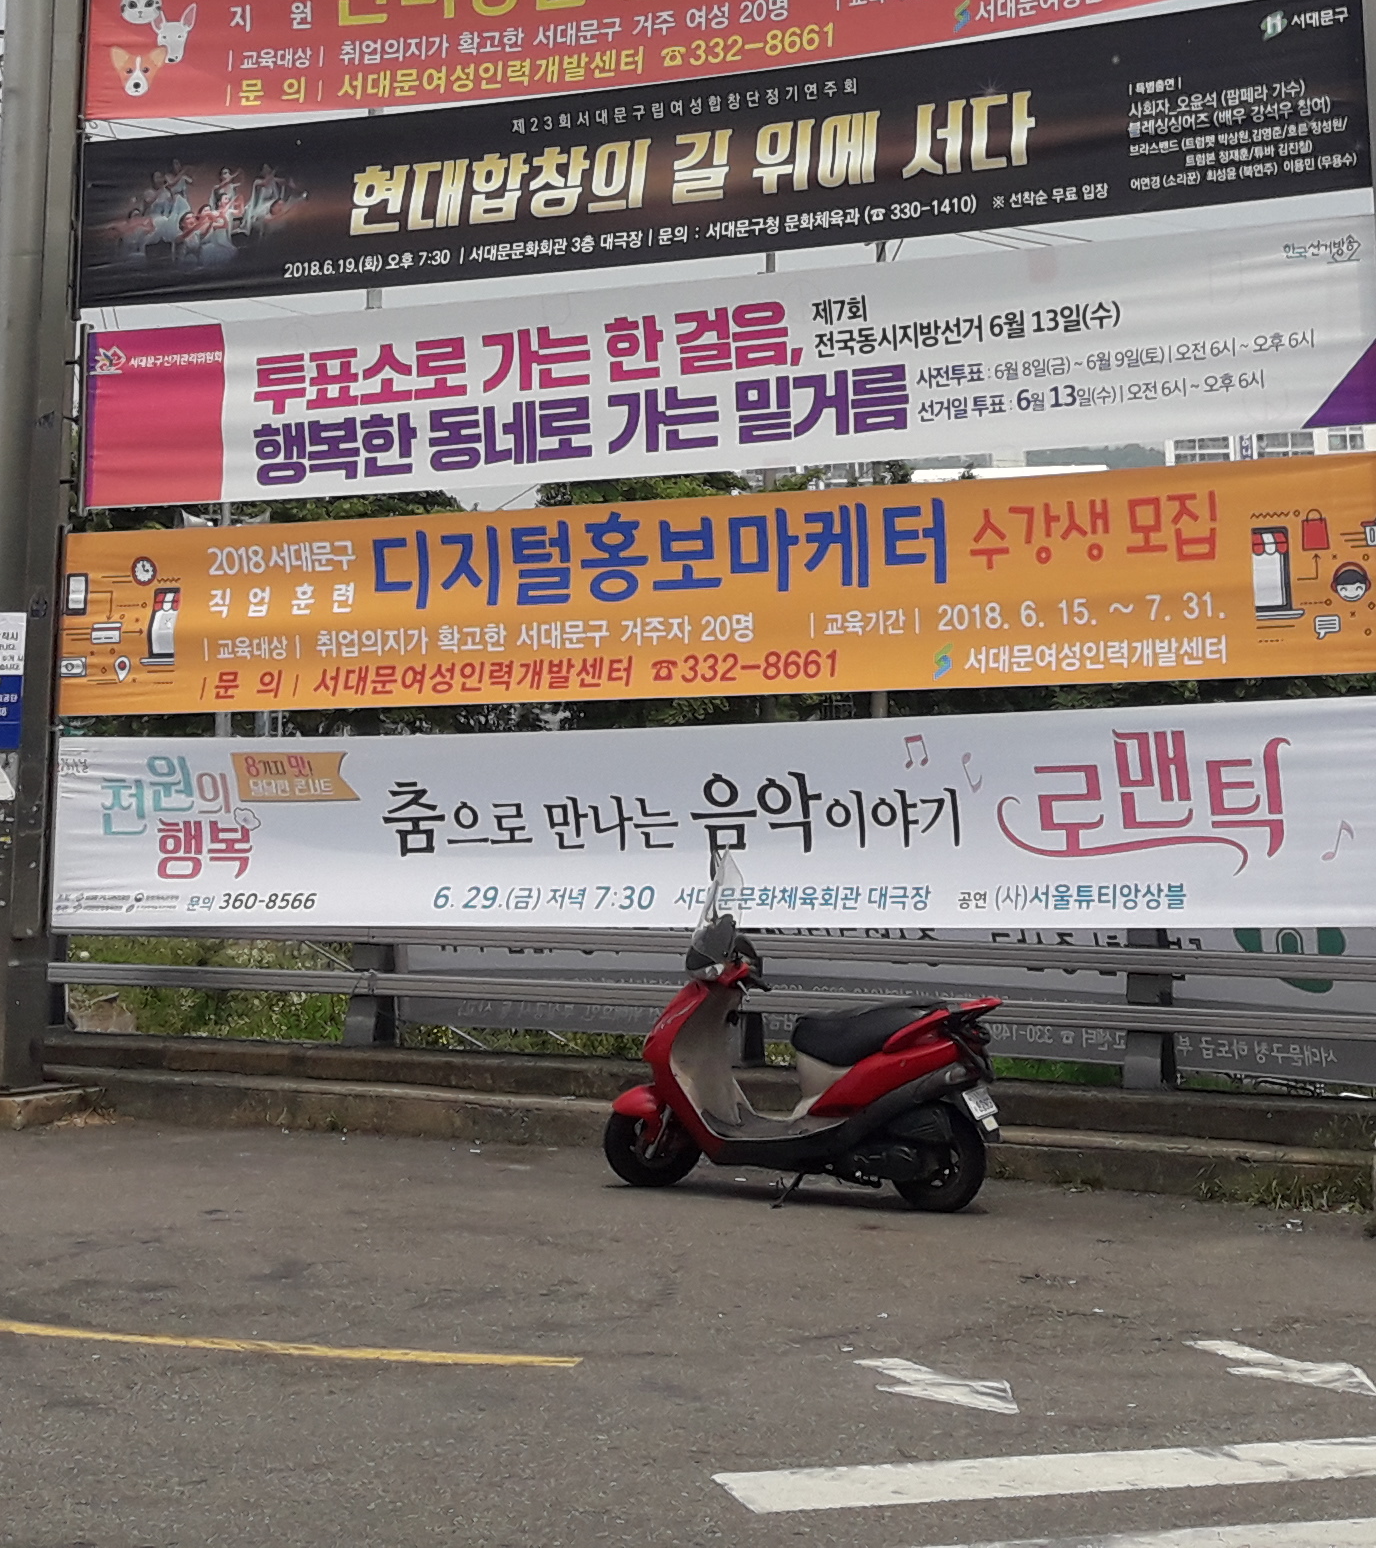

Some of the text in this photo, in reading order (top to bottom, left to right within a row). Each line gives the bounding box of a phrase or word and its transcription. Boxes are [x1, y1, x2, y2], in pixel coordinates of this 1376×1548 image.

[240, 49, 312, 70] 교육대상
[339, 34, 449, 65] 취업의지가
[458, 28, 524, 55] 확고한
[533, 18, 622, 48] 서대문구
[632, 11, 676, 39] 거주
[686, 2, 730, 30] 여성
[1291, 7, 1349, 30] 서대문구
[337, 46, 644, 100] 서대문여성인력개발센터
[1273, 80, 1305, 97] 가수)
[1213, 108, 1246, 127] (배우
[1250, 102, 1293, 122] 강석우
[1297, 97, 1331, 116] 참여)
[349, 90, 1036, 237] 현대합창의 길 위에 서다
[1009, 183, 1108, 208] 선착순 무료 입장
[284, 208, 860, 279] 2018.6.19.(화) 오후 7:30 서대문문화회관 3층 대극장 문의 서대문구청 문화체육과
[812, 295, 867, 326] 제7회
[815, 301, 1121, 359] 전국동시지방선거 6월 13일(수)
[254, 300, 804, 415] 투표소로 가는 한 걸음,
[917, 329, 1315, 389] 사전투표 6월 8일(금) 6월 9일(토) 오전 6시 오후 6시
[918, 369, 1265, 422] 선거일 투표 6월 13일(수) 오전 6시 오후 6시
[253, 364, 910, 486] 행복한 동네로 가는 밑거름
[207, 540, 356, 576] 2018 서대문구
[372, 490, 1217, 609] 디지털홍보마케터 수강생 모집
[216, 612, 755, 660] 교육대상 취업의지가 확고한 서대문구 거주자 20명
[824, 592, 1227, 636] 교육기간 2018. 6. 15. 7. 31.
[313, 655, 633, 696] 서대문여성인력개발센터
[964, 634, 1228, 673] 서대문여성인력개발센터
[101, 755, 231, 836] 천원의
[382, 771, 961, 857] 춤으로 만나는 음악이야기
[997, 729, 1292, 876] 로맨틱
[157, 818, 253, 880] 행복
[187, 895, 215, 911] 문의
[219, 893, 317, 910] 360-8566
[546, 886, 931, 911] 저녁 7:30 대극장
[958, 883, 1187, 911] 공연 (사)서울튜티앙상블
